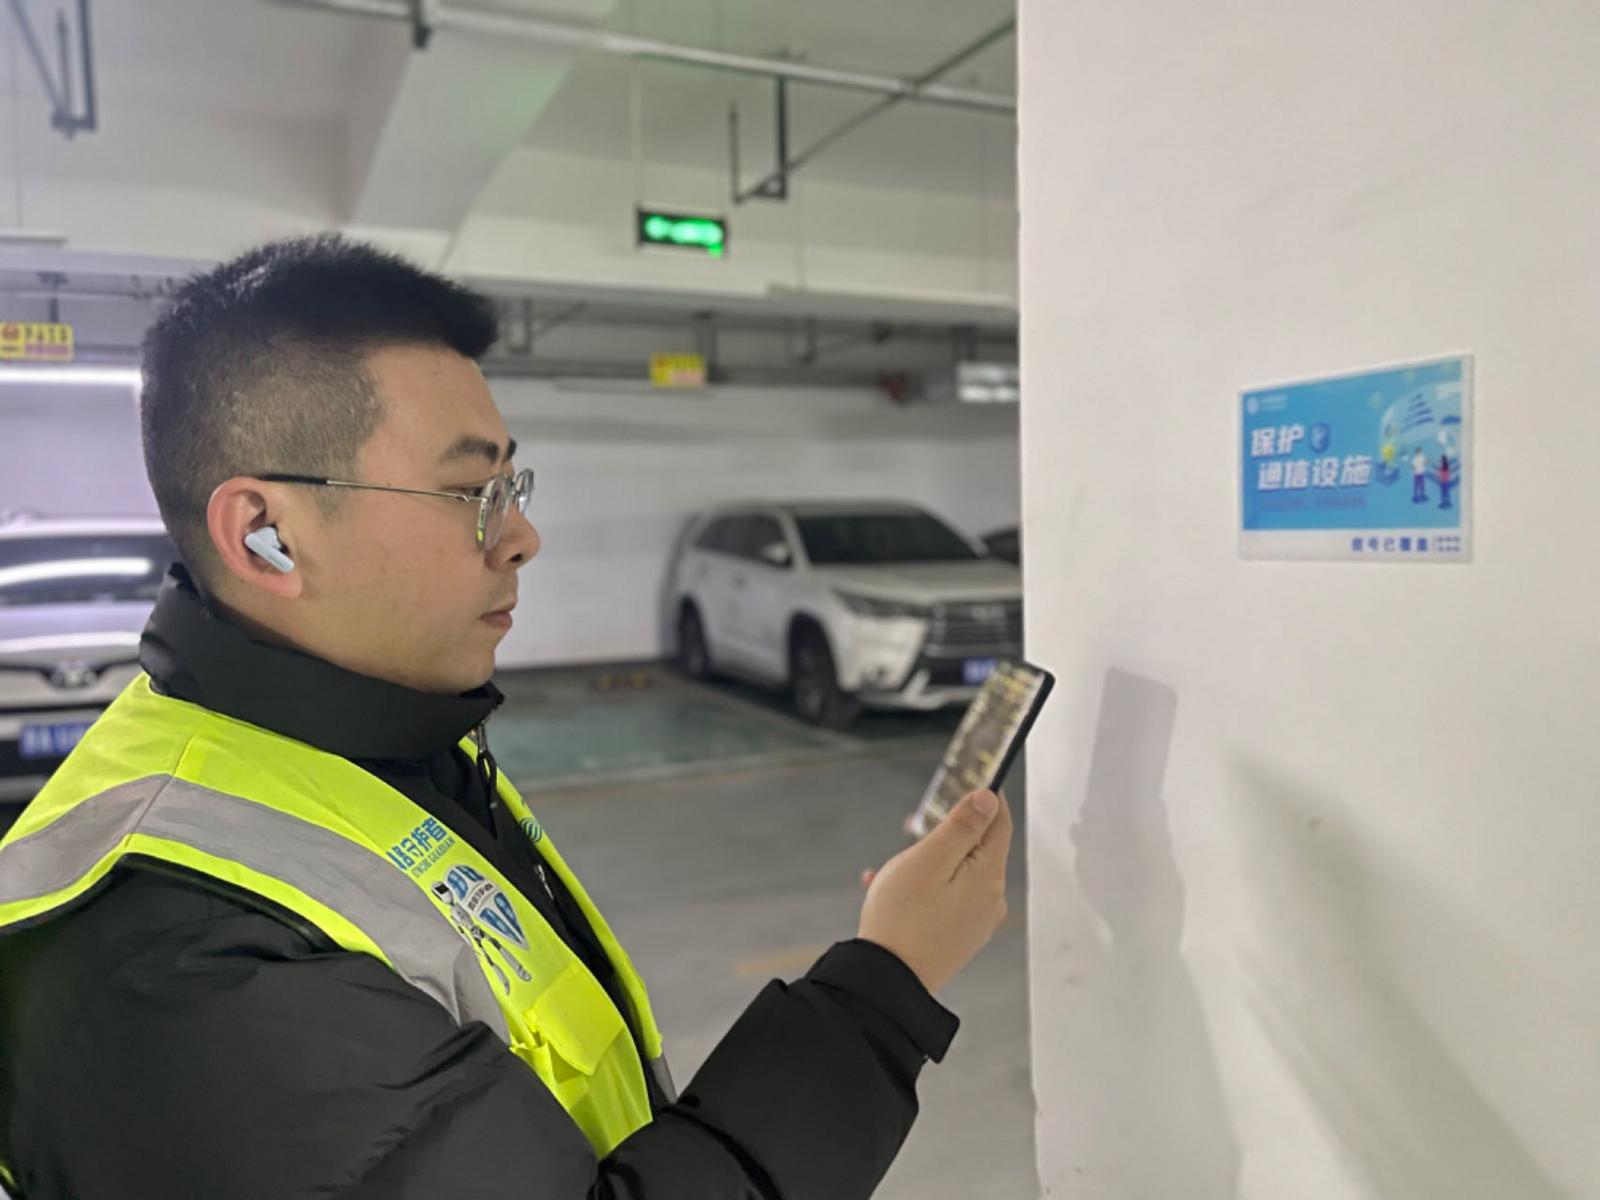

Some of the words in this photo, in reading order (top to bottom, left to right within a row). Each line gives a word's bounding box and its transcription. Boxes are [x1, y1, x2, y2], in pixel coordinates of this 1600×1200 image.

[1251, 424, 1305, 457] 保护
[1257, 455, 1371, 491] 通信设施
